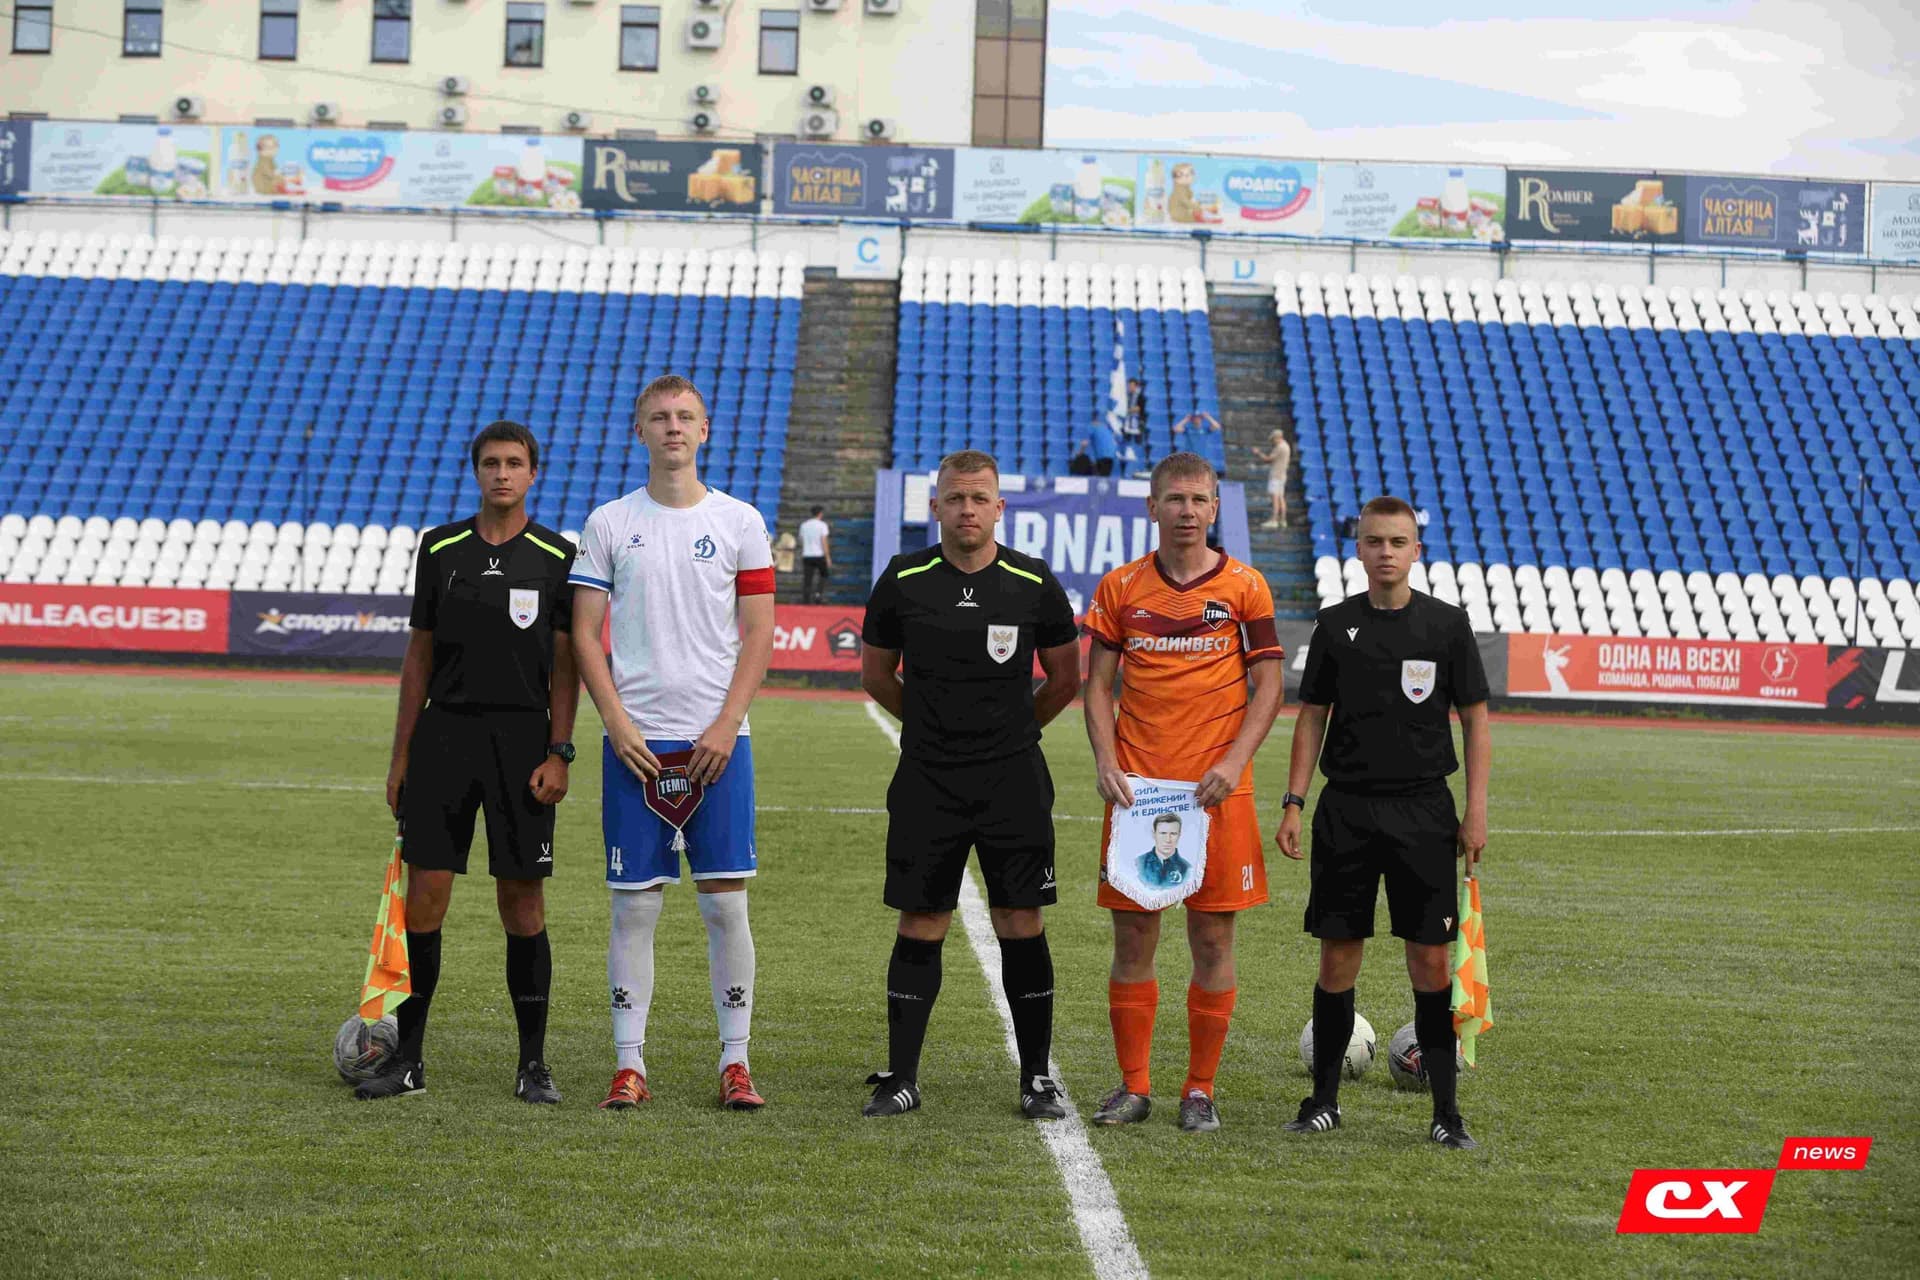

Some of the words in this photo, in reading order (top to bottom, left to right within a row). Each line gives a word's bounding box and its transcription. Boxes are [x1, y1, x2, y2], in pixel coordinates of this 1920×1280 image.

[791, 166, 862, 188] ЧАСТИЦА
[791, 185, 842, 204] АЛТАЯ
[1704, 197, 1774, 221] ЧАСТИЦА
[1704, 216, 1753, 236] АЛТАЯ
[857, 237, 879, 264] C
[0, 602, 207, 632] NLEAGUE2B
[837, 631, 856, 648] 2
[1599, 643, 1651, 673] ОДНА
[1656, 645, 1682, 671] НА
[1686, 646, 1741, 673] ВСЕХ!
[1598, 671, 1649, 689] КОМАНДА,
[1652, 673, 1695, 689] РОДИНА,
[1697, 675, 1740, 691] ПОБЕДА!
[660, 778, 688, 794] ТЕМП
[1134, 786, 1159, 796] СИЛА
[1135, 793, 1187, 807] ДВИЖЕНИИ
[1142, 803, 1190, 817] ЕДИНСТВЕ
[611, 846, 624, 876] 4
[1241, 863, 1254, 892] 21
